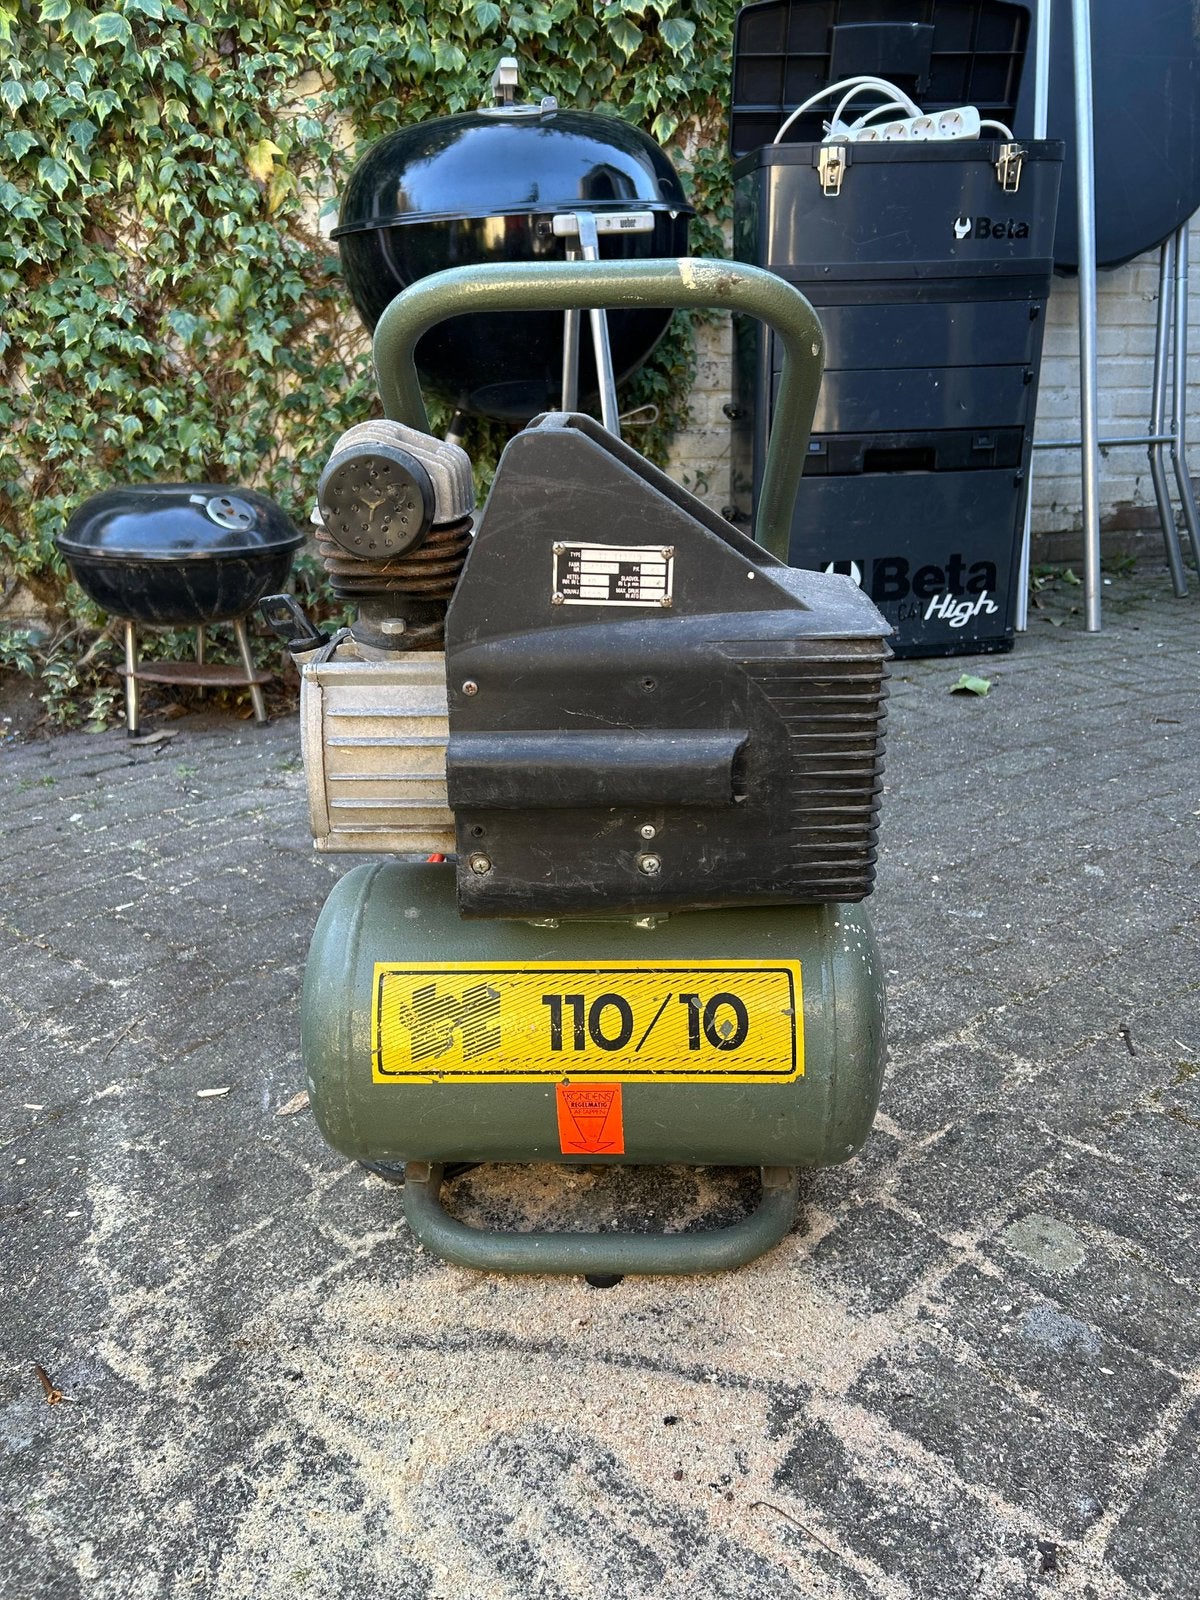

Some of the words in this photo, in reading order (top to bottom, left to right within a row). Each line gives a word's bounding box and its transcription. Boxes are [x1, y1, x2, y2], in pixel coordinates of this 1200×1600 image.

[975, 216, 1029, 239] Beta
[872, 553, 997, 602] Beta
[924, 590, 998, 627] High
[566, 1092, 611, 1101] KONDENS
